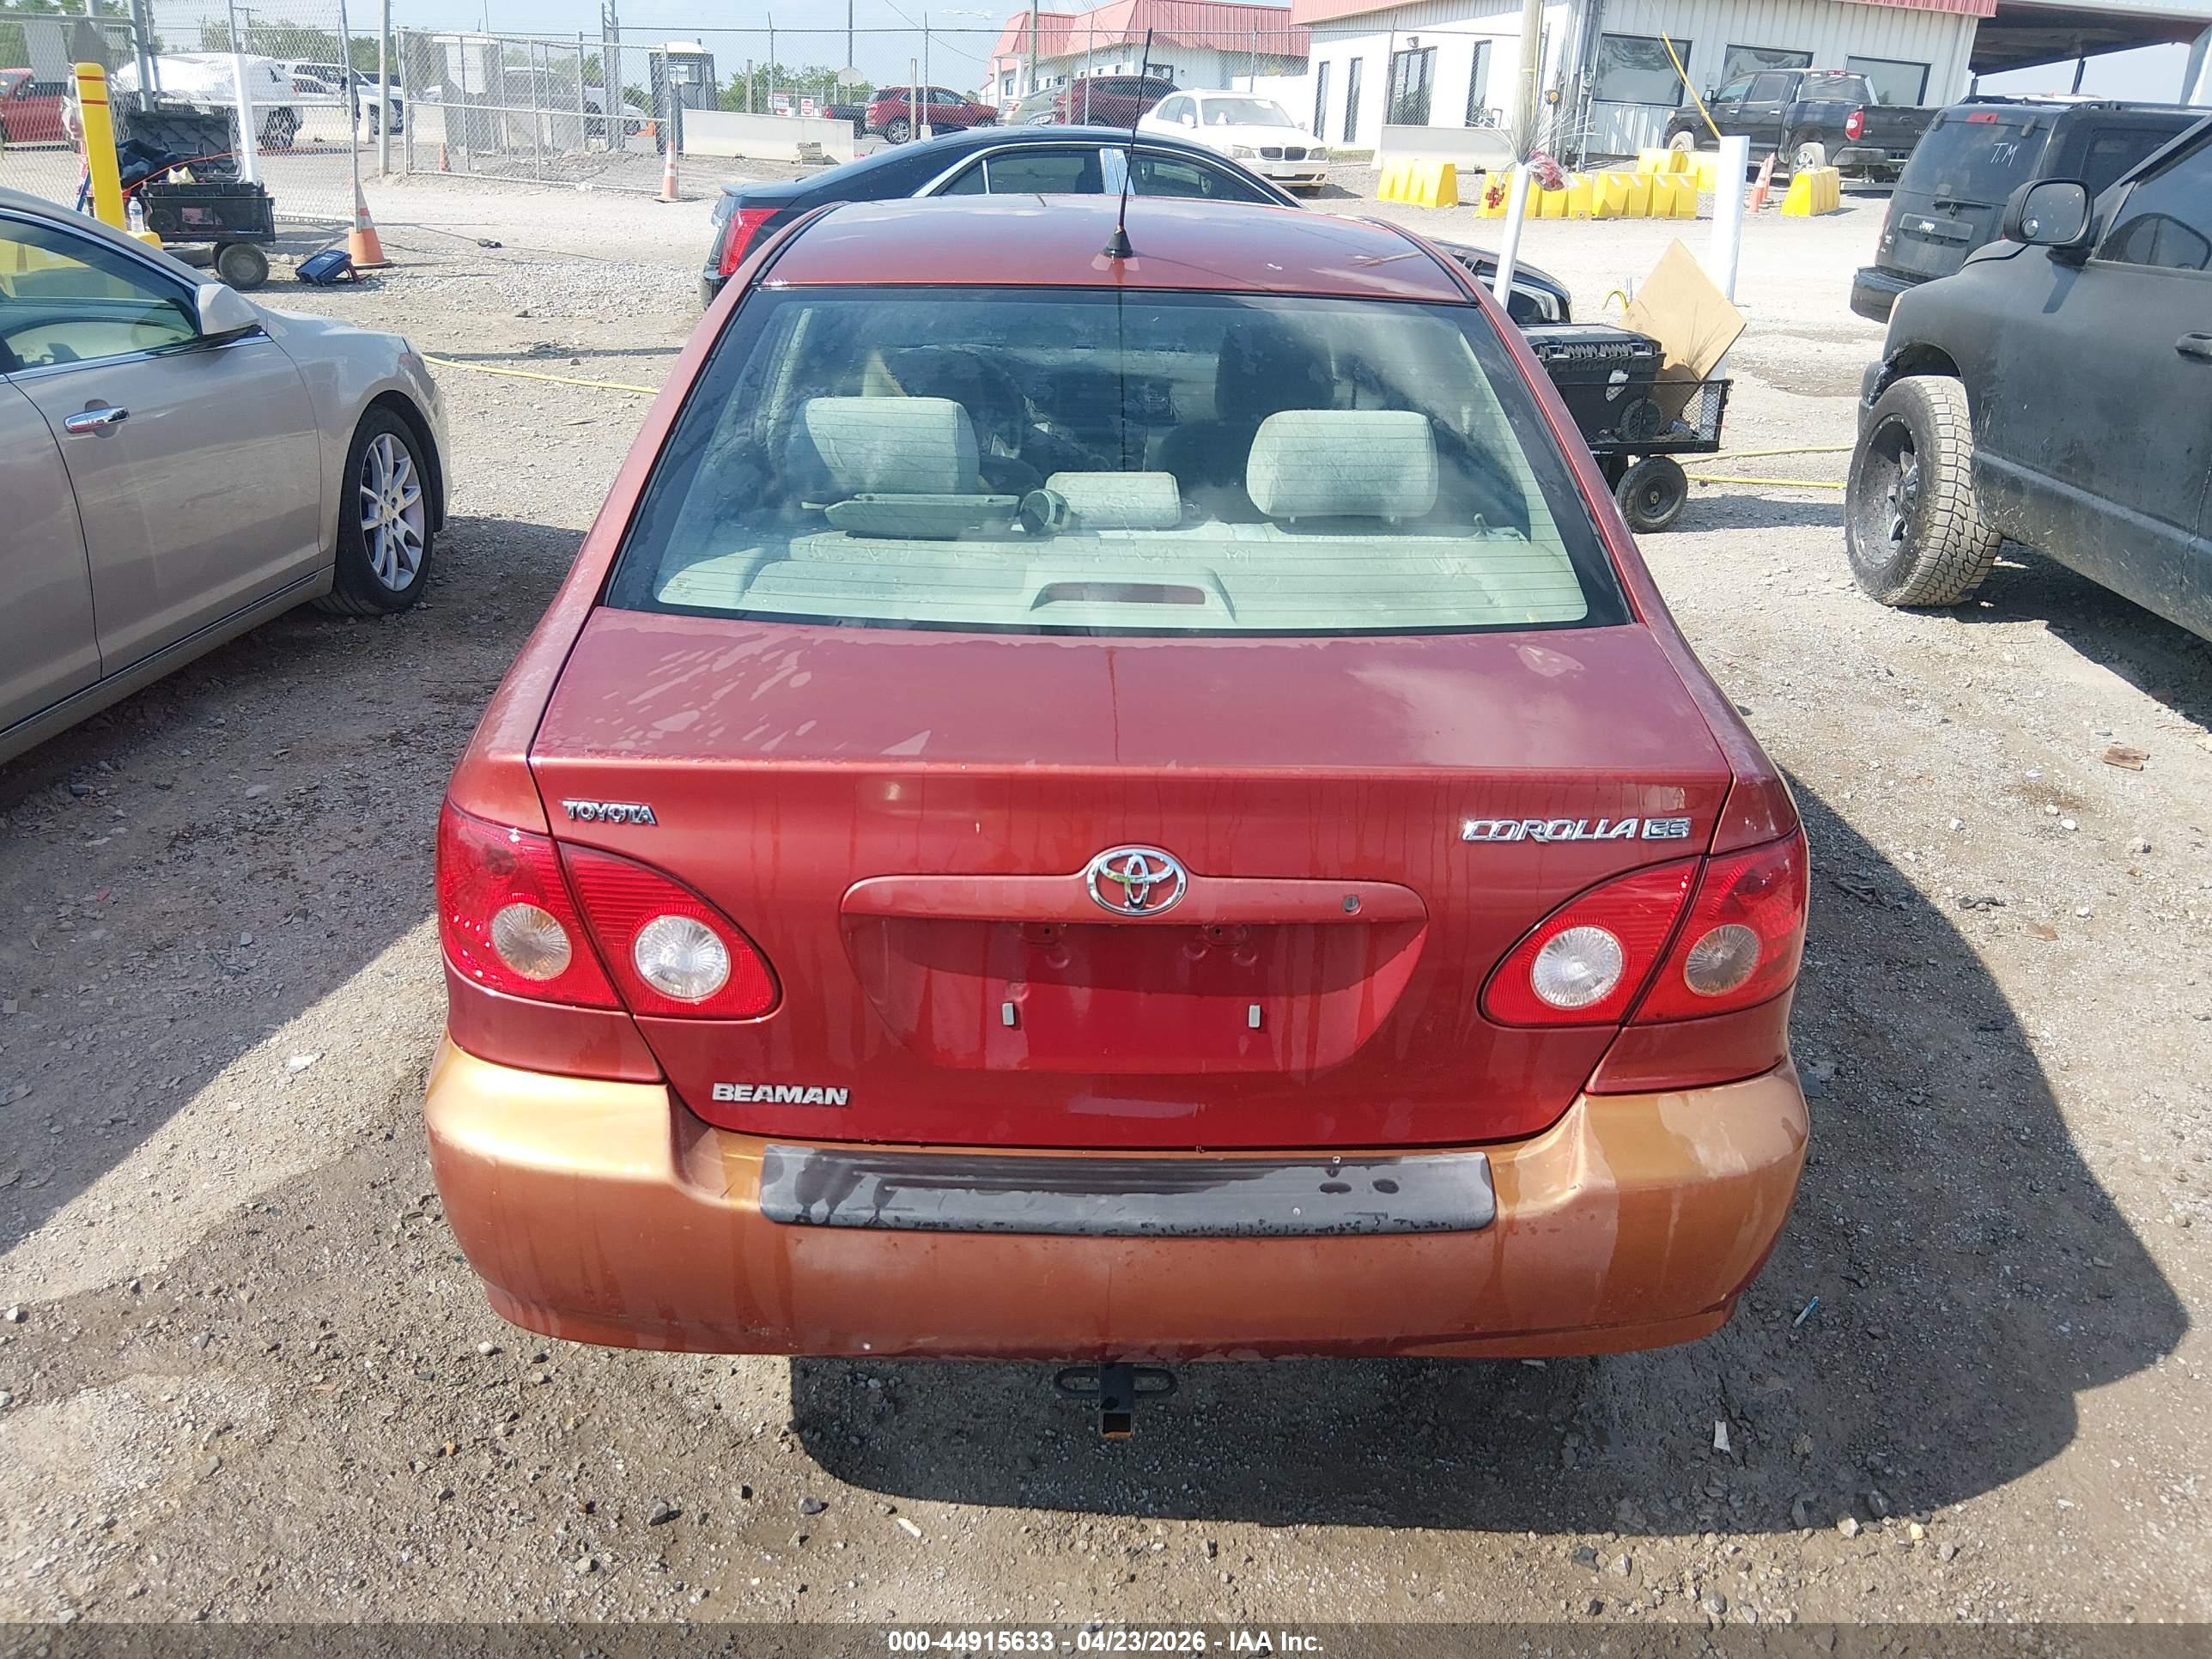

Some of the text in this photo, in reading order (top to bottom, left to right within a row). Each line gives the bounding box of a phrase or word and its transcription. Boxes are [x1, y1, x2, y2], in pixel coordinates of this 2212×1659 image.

[562, 800, 656, 824] TOYOTA
[1462, 818, 1639, 842] COROLLA
[712, 1082, 848, 1105] BEAMAN
